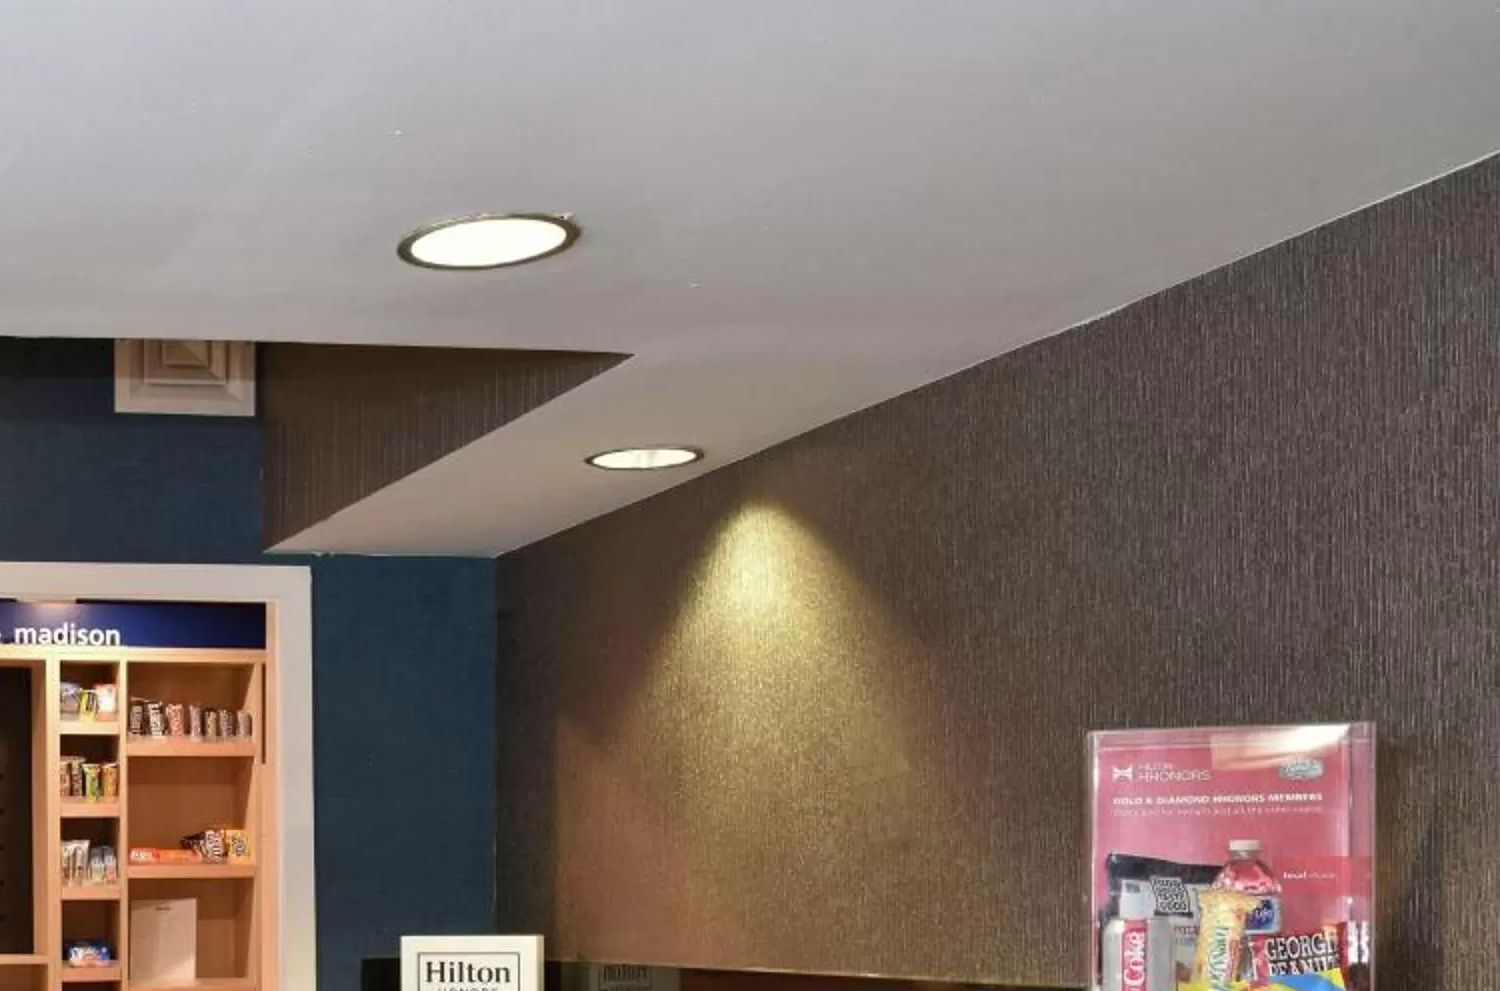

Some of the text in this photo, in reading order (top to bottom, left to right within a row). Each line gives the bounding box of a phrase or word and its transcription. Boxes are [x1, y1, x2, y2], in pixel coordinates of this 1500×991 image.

[14, 623, 121, 646] madison
[1123, 931, 1145, 987] Coke
[425, 960, 511, 984] Hilton
